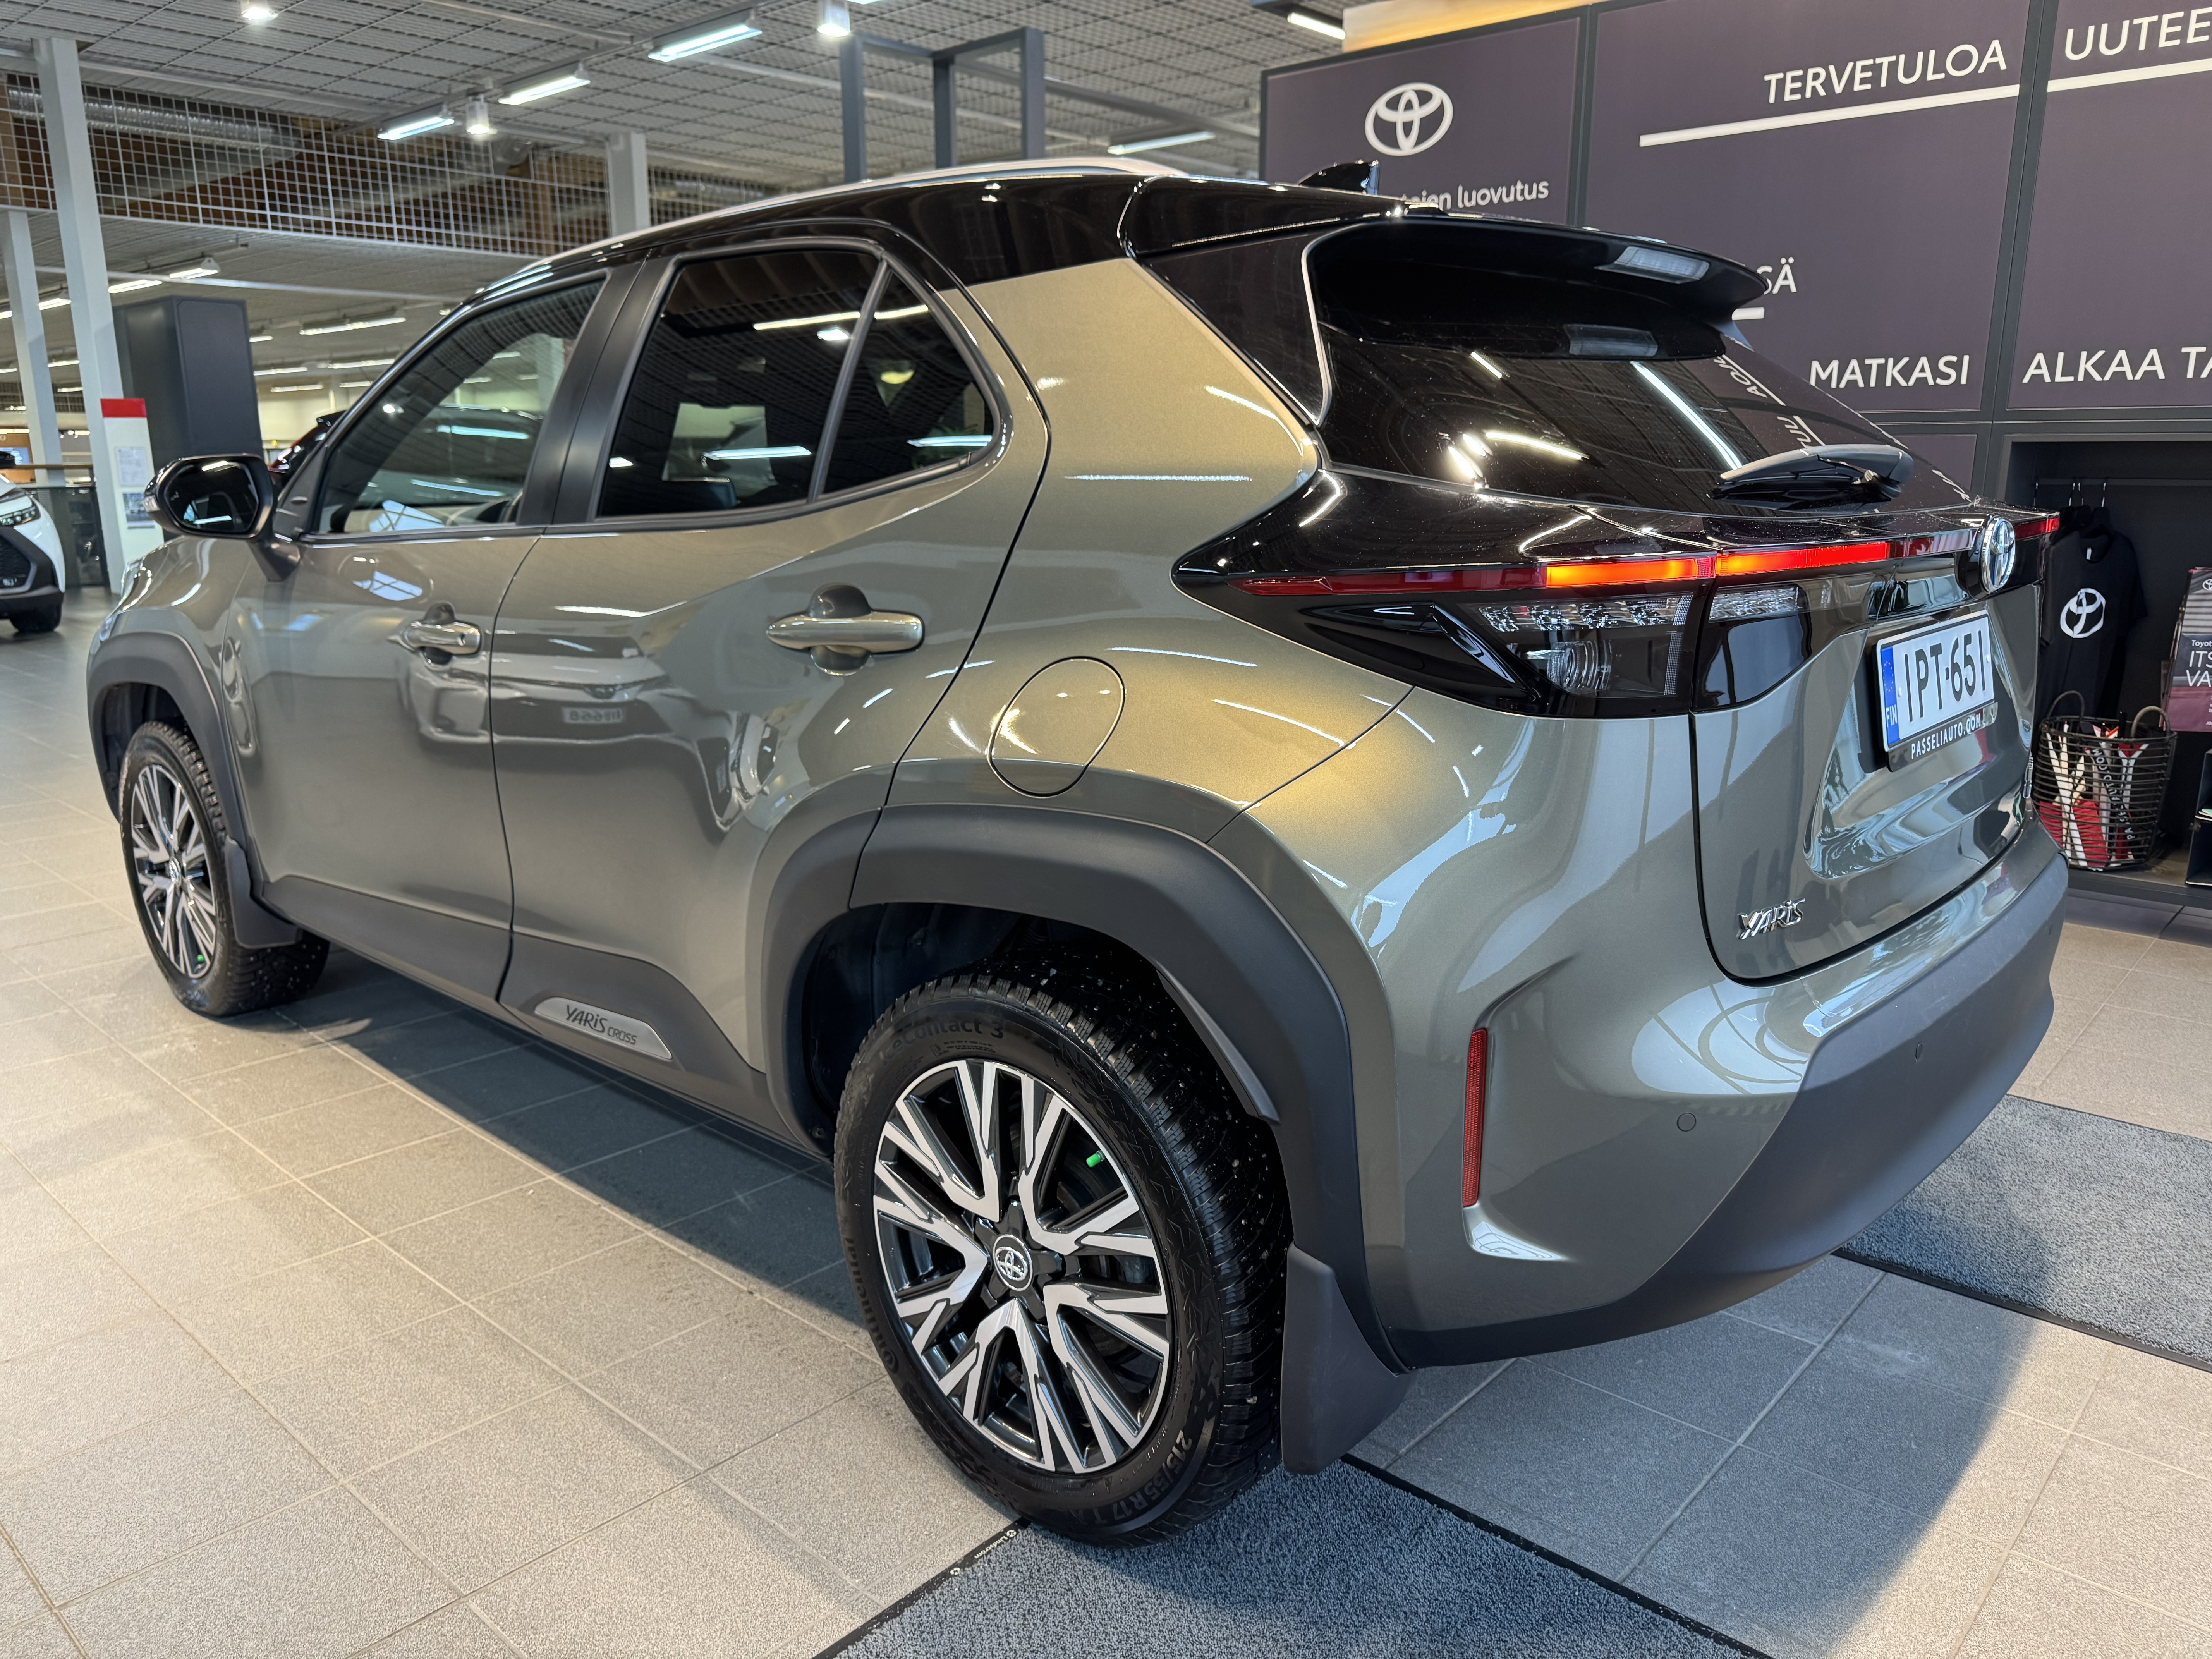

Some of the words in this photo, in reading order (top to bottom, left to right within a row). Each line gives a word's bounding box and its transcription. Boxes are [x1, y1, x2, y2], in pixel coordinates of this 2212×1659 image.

[1764, 39, 2008, 105] TERVETULOA
[1457, 180, 1549, 208] luovutus
[1809, 354, 1970, 389] MATKASI
[2022, 348, 2165, 383] ALKAA
[1905, 630, 1986, 723] IPT-651
[1885, 704, 1898, 728] FIN
[1911, 713, 1981, 759] PASSELIAUTO.COM
[607, 1027, 637, 1045] CROSS
[991, 1020, 1005, 1039] 3
